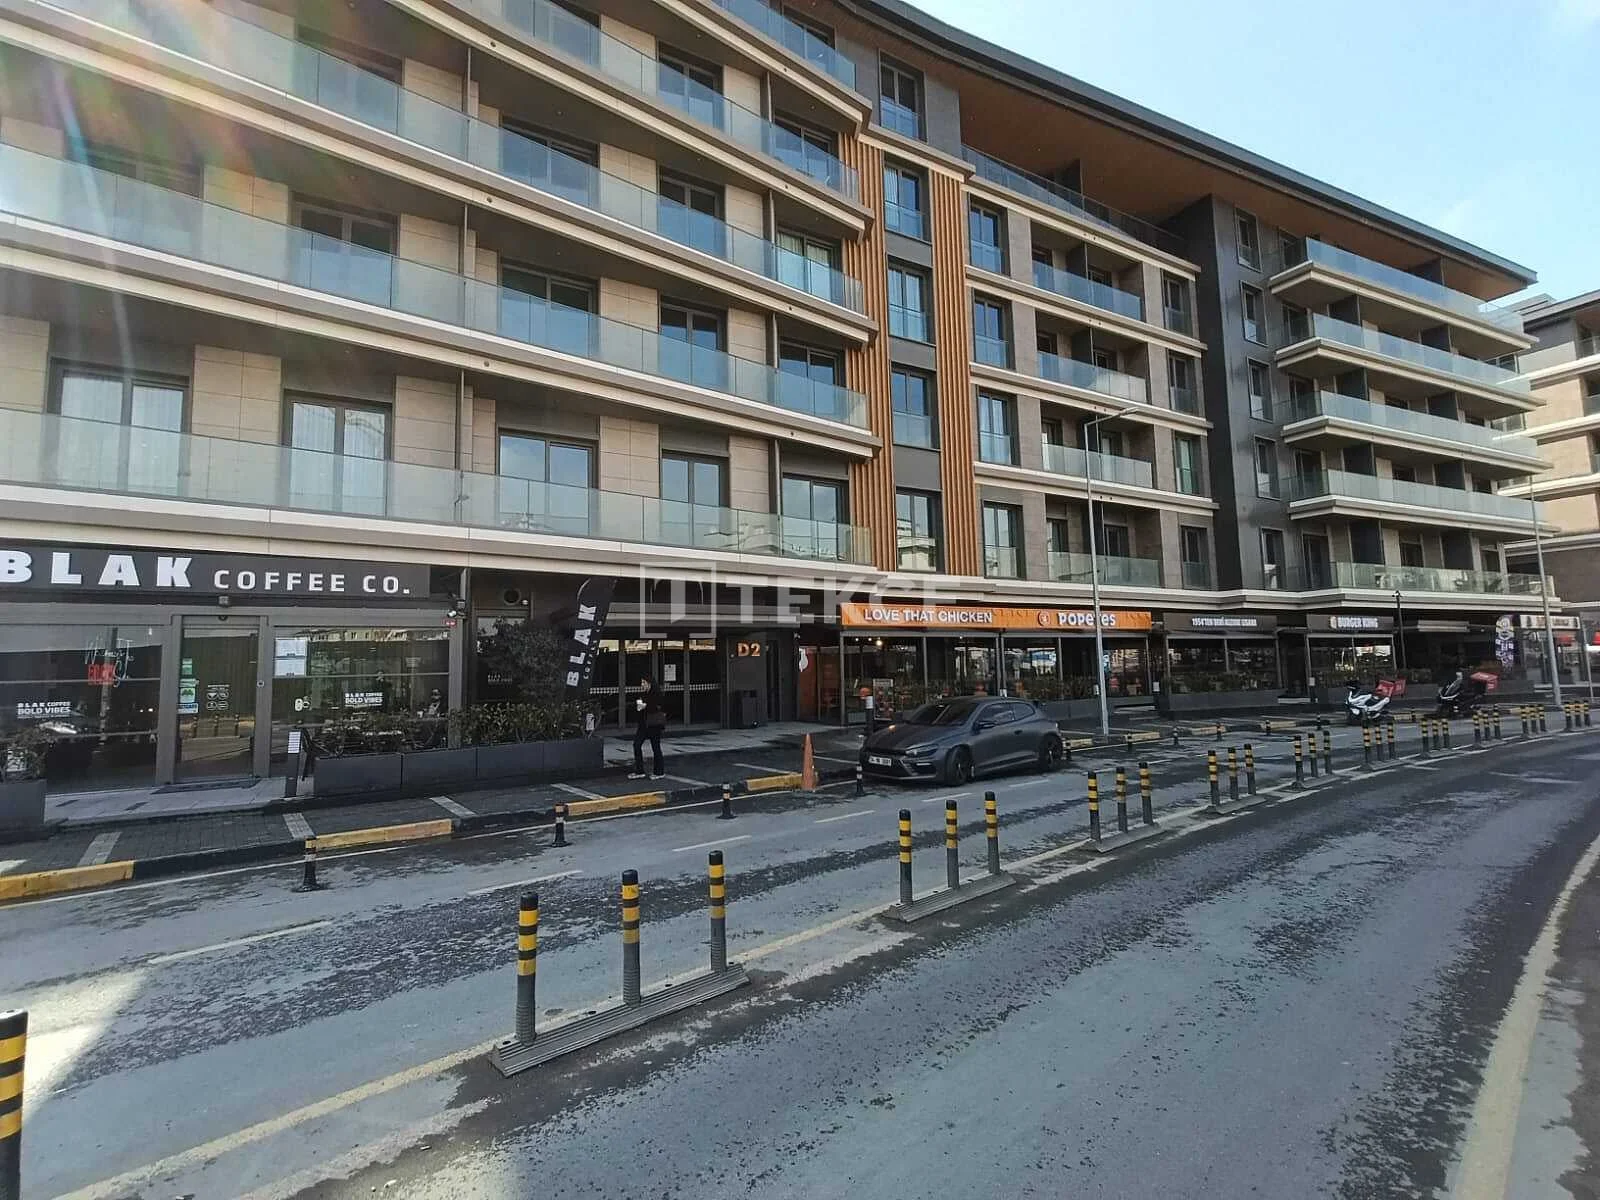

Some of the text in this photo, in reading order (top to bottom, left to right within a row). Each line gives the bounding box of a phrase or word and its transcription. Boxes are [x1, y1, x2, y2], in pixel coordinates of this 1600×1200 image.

[0, 550, 410, 594] BLAK COFFEE CO.
[864, 608, 993, 623] LOVE THAT CHICKEN
[1338, 617, 1362, 628] BURGER
[566, 604, 597, 687] BLAK
[737, 642, 761, 657] D2
